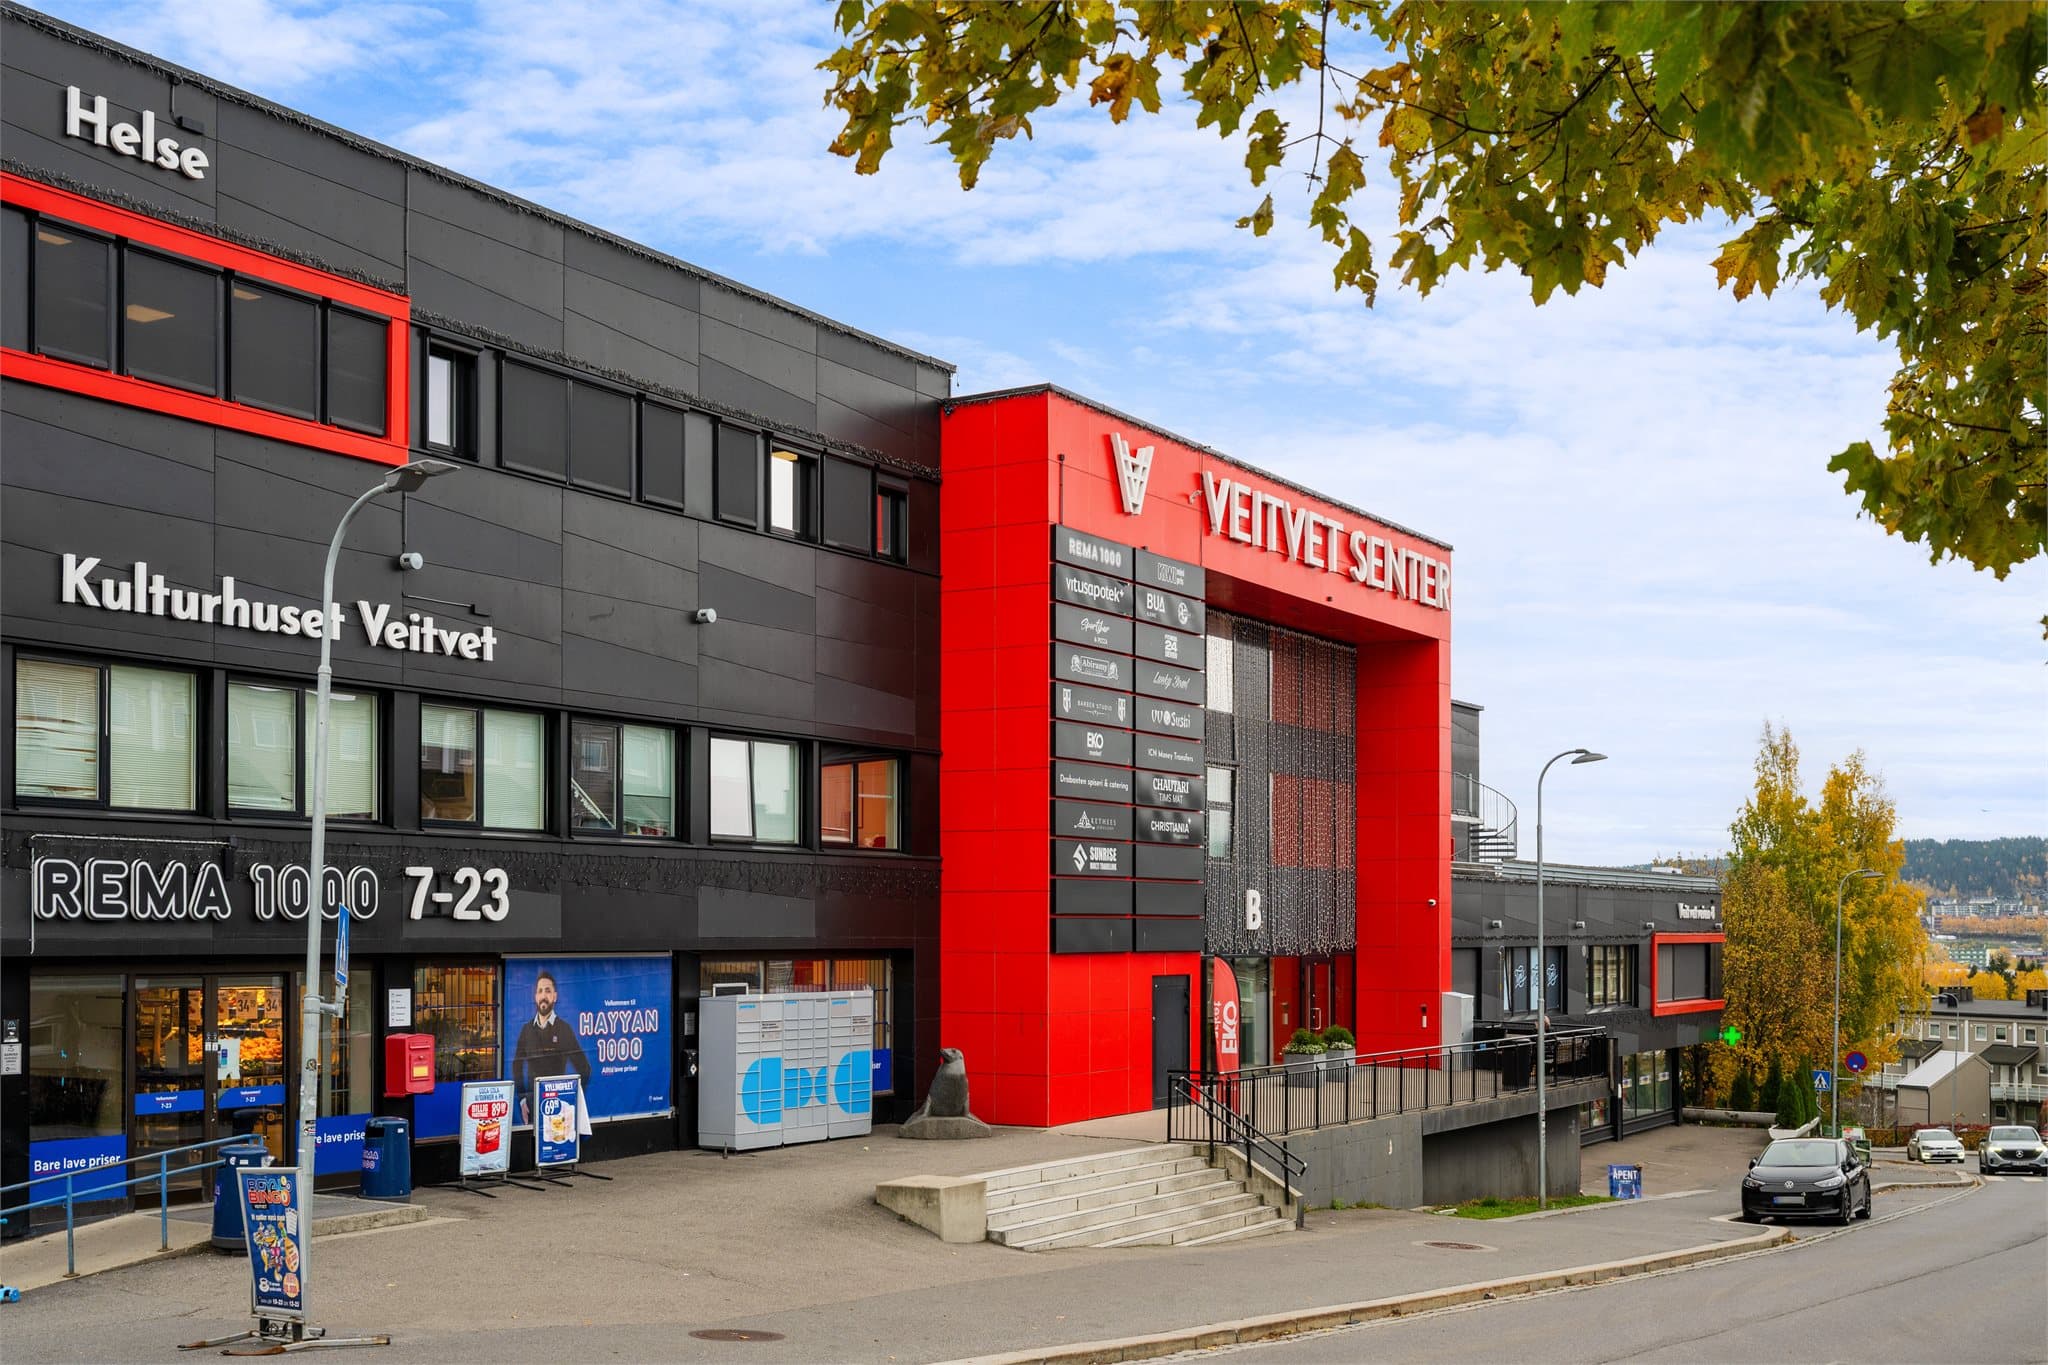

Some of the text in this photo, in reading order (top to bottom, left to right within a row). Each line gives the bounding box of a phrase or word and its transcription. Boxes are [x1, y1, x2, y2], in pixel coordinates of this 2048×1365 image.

[66, 85, 209, 179] Helse
[1202, 471, 1452, 612] VEITVET SENTER
[1068, 537, 1122, 568] REMA 1000
[62, 553, 497, 662] Kulturhuset Veitvet
[1146, 593, 1165, 613] BUA
[1164, 641, 1178, 653] 24
[1096, 702, 1113, 712] STUDIO
[1170, 711, 1191, 729] Sushi
[1086, 732, 1104, 749] EKO
[1104, 779, 1108, 787] &
[1109, 780, 1129, 791] catering
[1152, 778, 1189, 794] CHAUTARI
[1151, 820, 1190, 834] CHRISTIANIA
[1089, 846, 1117, 862] SUNRISE
[33, 856, 510, 922] REMA 1000 7-23
[1246, 889, 1262, 930] B
[237, 999, 250, 1012] 34
[579, 1009, 659, 1036] HAYYAN
[597, 1037, 643, 1063] 1000
[491, 1102, 501, 1117] 89
[544, 1100, 555, 1115] 69
[324, 1132, 342, 1143] lave
[344, 1130, 366, 1143] prise
[34, 1154, 120, 1173] Bare lave priser
[1612, 1167, 1638, 1180] ÅPENT
[248, 1189, 291, 1206] BINGO
